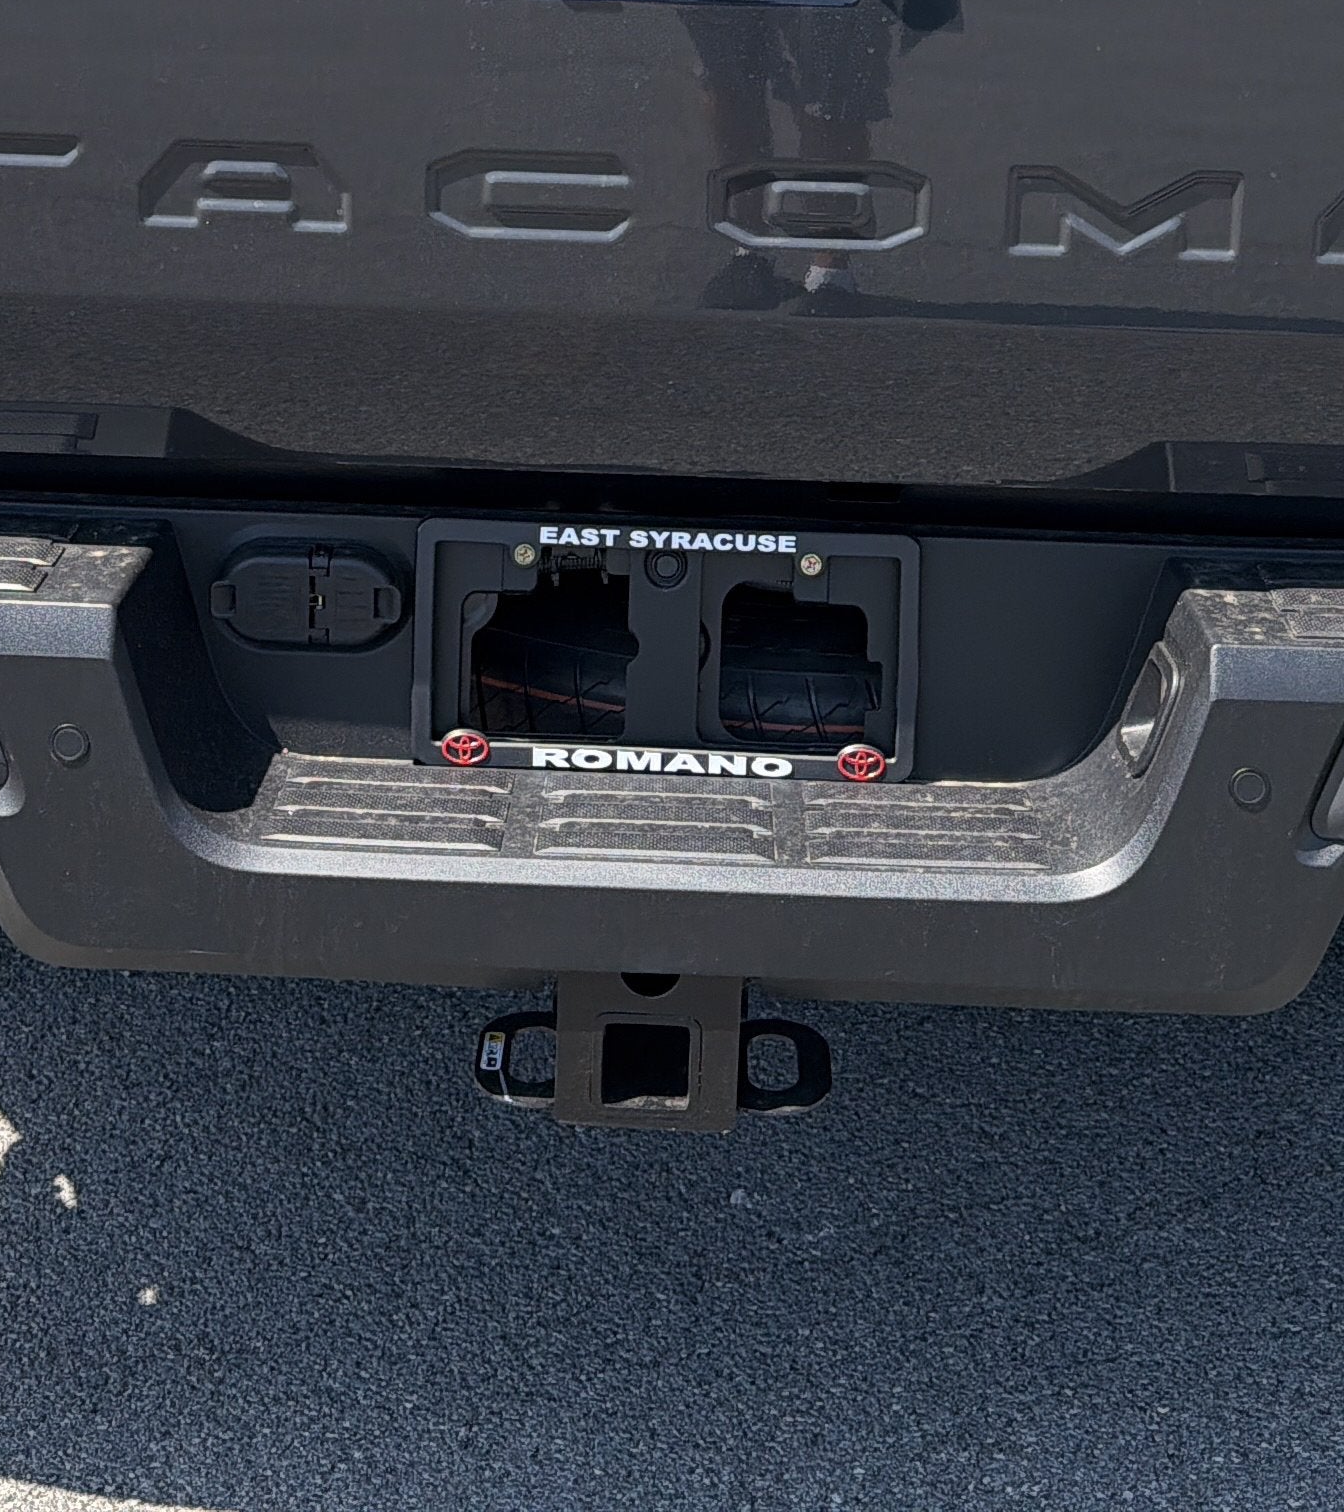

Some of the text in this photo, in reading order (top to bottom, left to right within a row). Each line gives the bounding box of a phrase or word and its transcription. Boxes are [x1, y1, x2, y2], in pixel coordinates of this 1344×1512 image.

[539, 525, 797, 554] EAST SYRACUSE
[531, 745, 794, 779] ROMANO
